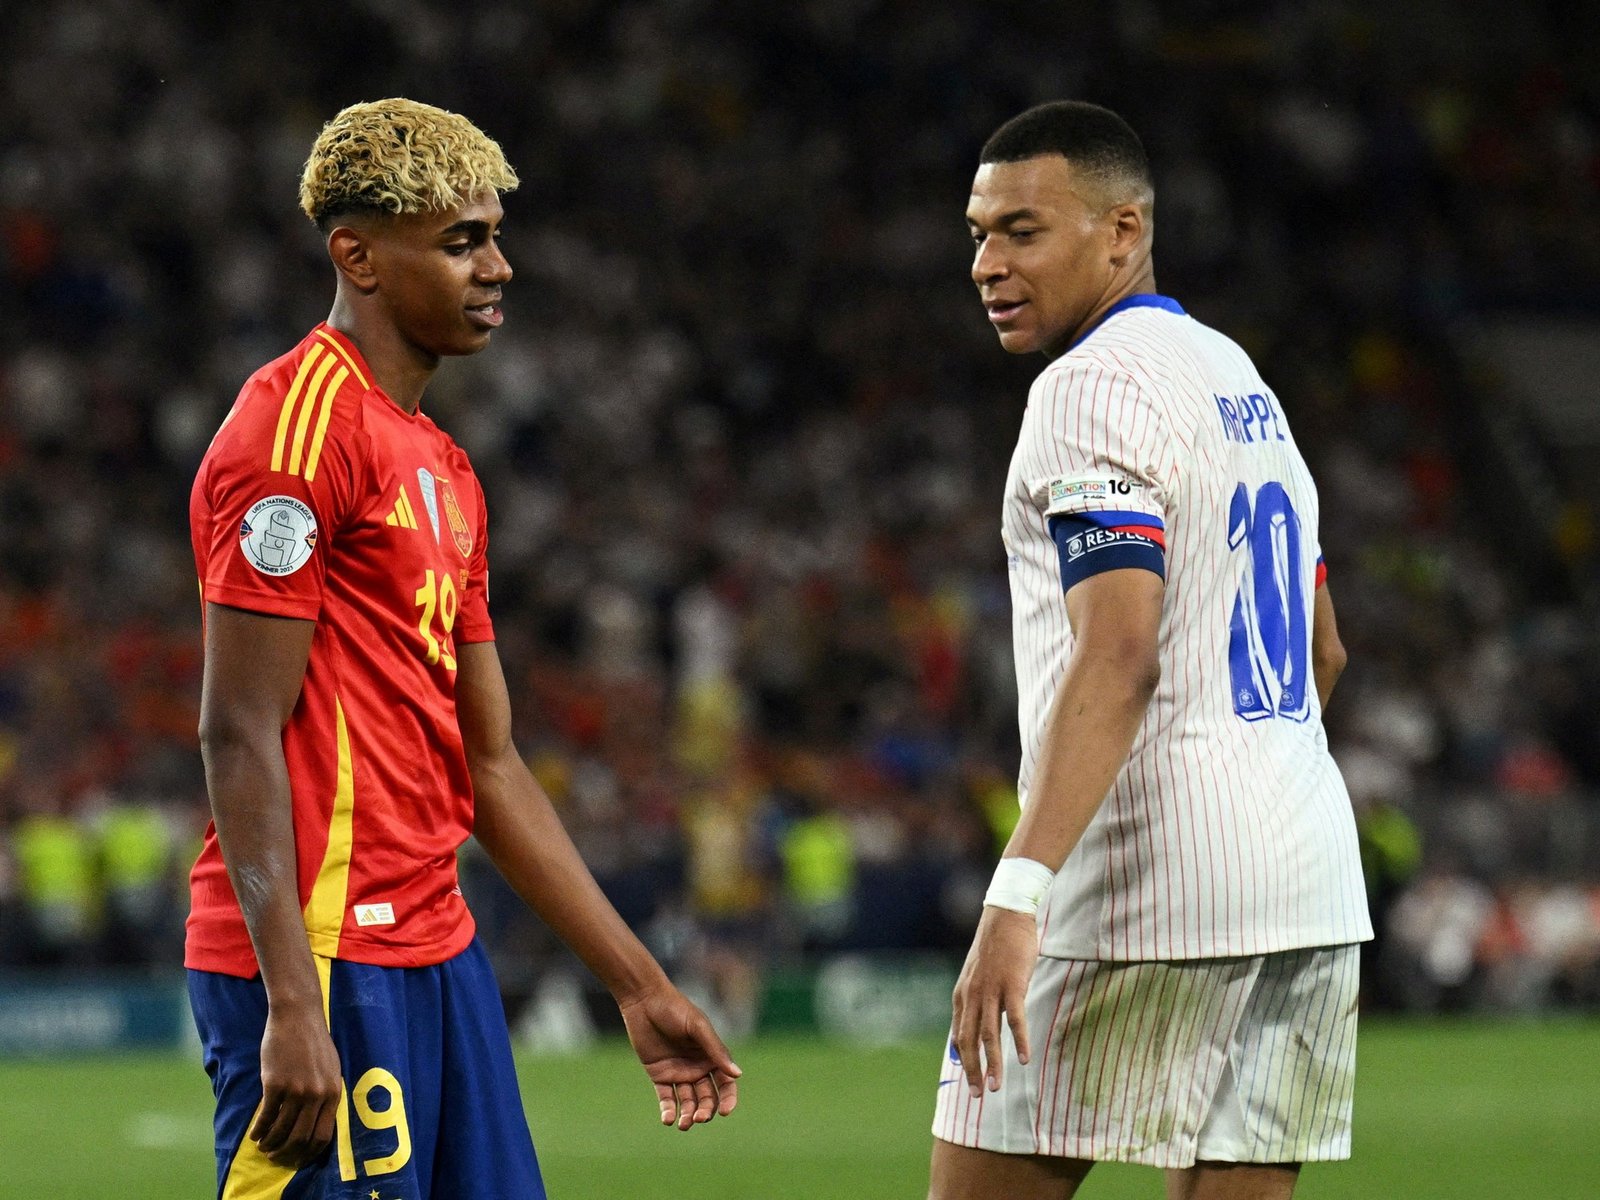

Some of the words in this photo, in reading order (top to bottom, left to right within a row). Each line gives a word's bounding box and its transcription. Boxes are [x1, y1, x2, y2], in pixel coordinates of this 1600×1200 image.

[252, 502, 266, 513] UEFA
[266, 498, 294, 506] NATIONS
[294, 502, 312, 520] LEAGUE
[1086, 530, 1151, 547] RESPE
[256, 561, 279, 573] WINNER
[415, 569, 457, 671] 19
[1227, 481, 1310, 723] 10
[336, 1067, 412, 1182] 19
